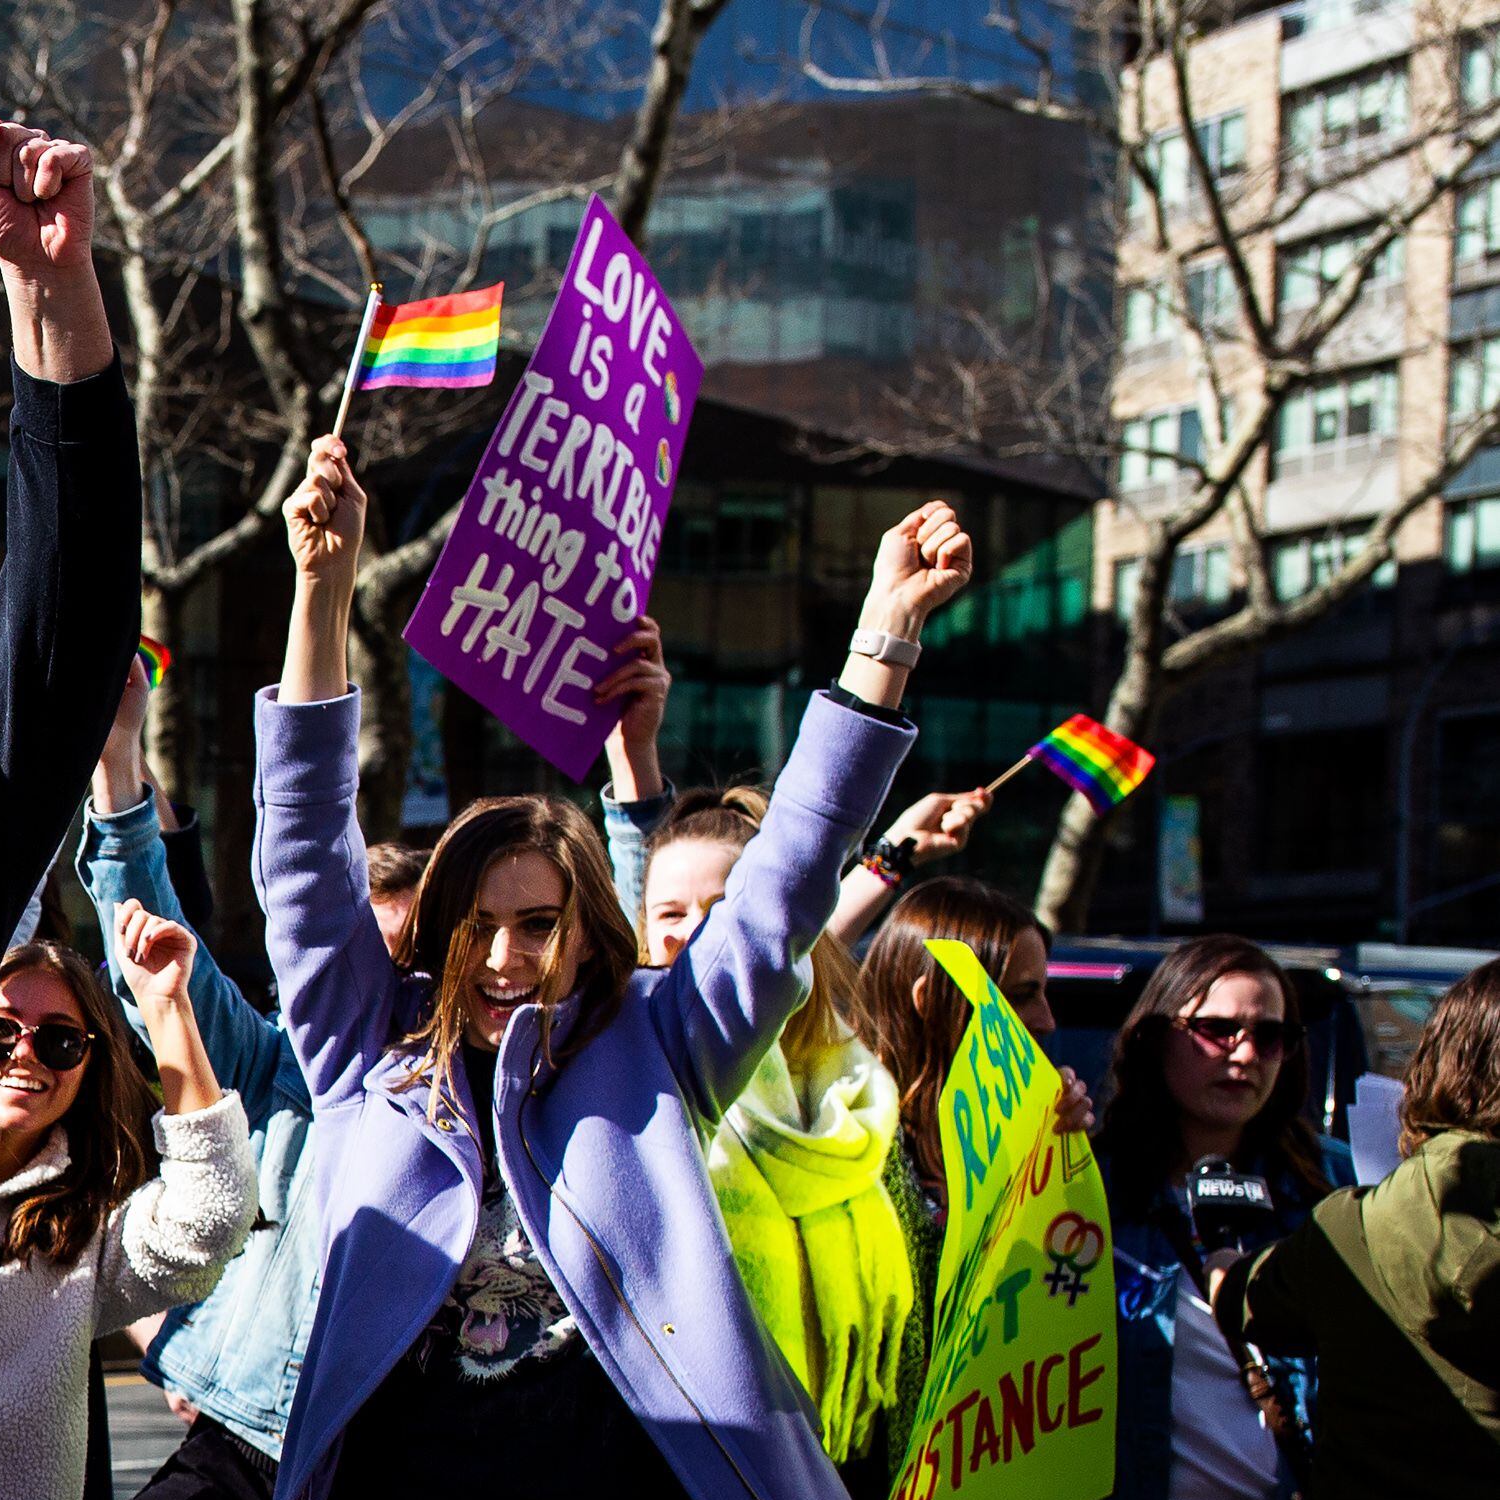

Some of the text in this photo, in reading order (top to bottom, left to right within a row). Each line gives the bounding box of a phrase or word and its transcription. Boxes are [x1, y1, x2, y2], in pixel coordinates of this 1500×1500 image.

[569, 304, 647, 436] is a
[573, 217, 673, 387] LOVE
[477, 467, 638, 624] thing to
[497, 371, 662, 581] TERRIBLE
[440, 553, 609, 725] HATE
